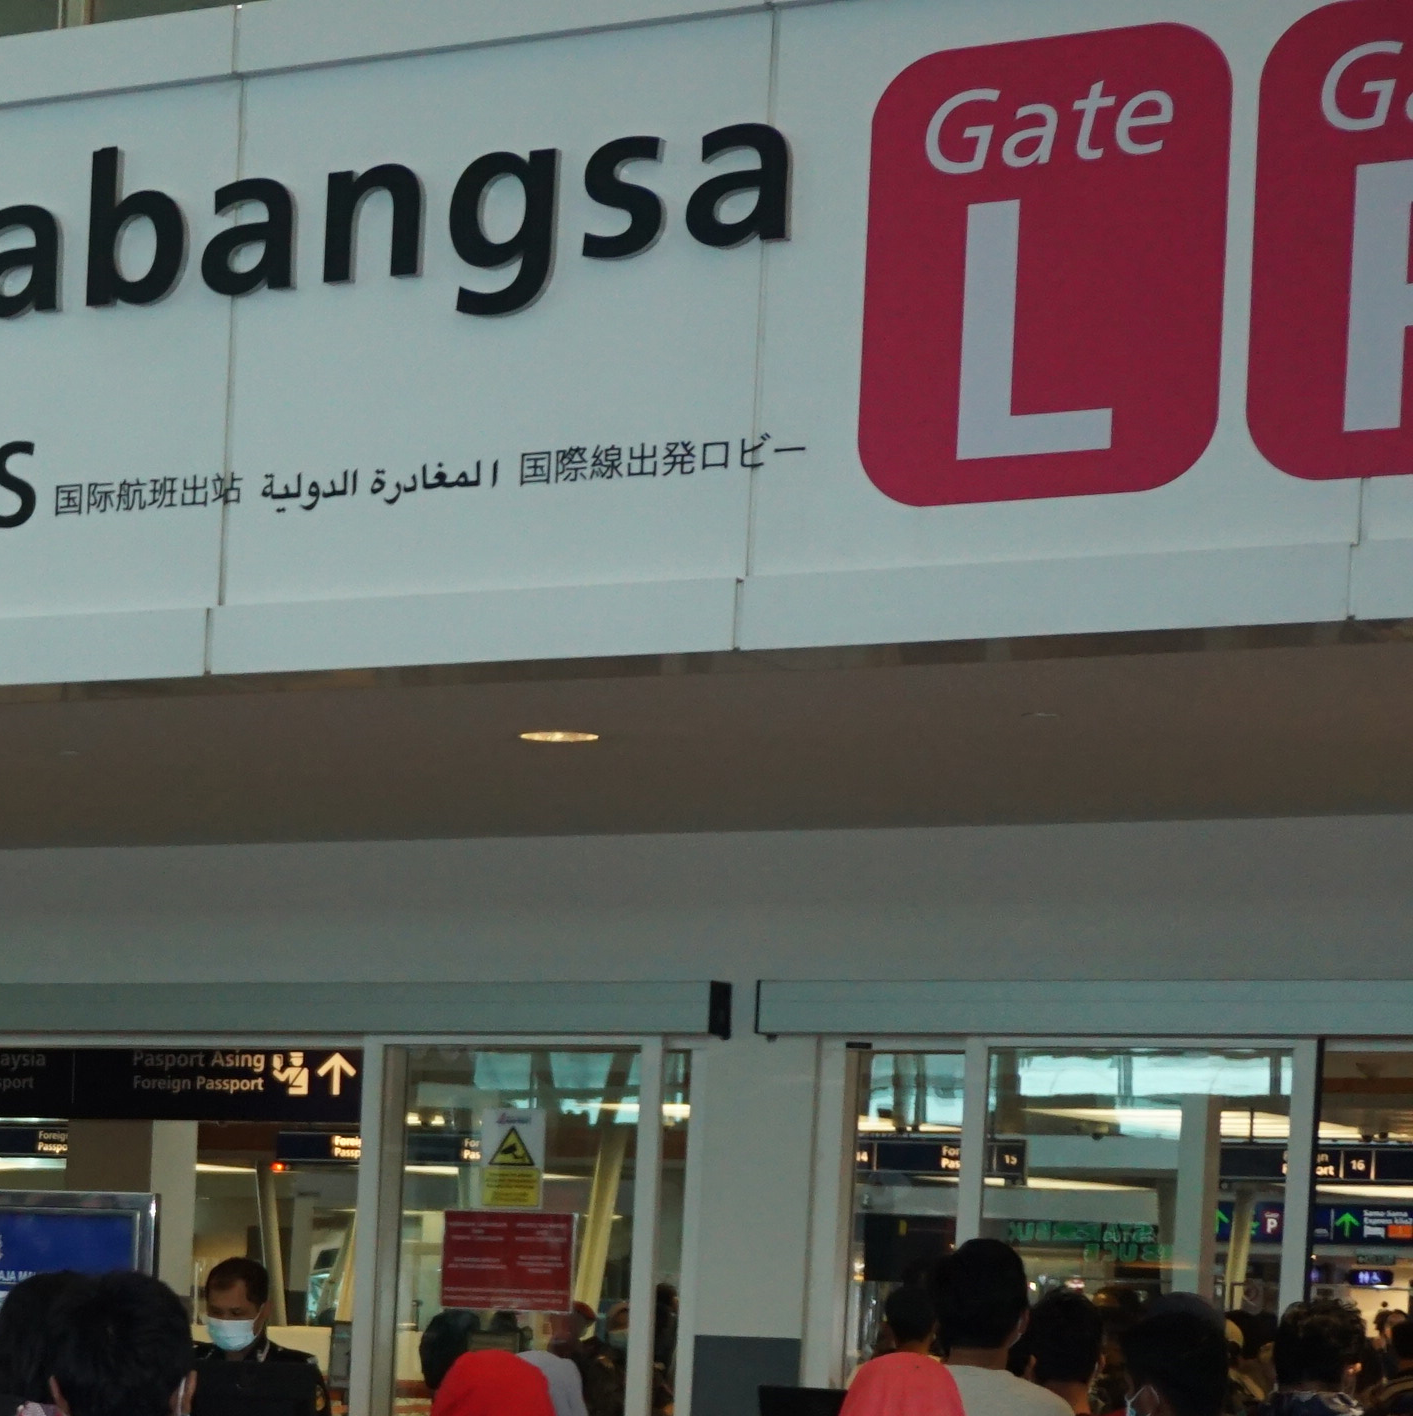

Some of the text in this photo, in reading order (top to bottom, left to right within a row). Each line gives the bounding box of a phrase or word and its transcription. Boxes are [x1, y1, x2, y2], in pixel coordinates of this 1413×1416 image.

[1321, 40, 1413, 131] G
[924, 80, 1174, 175] Gate
[956, 199, 1113, 460] L
[518, 432, 808, 488] 国際線出発ロビー
[53, 474, 243, 517] 国际航班出站
[260, 458, 500, 513] المغادرة الدولية
[132, 1050, 265, 1078] Pasport Asing
[132, 1076, 265, 1100] Foreign Passport
[37, 1141, 69, 1155] Passpo
[38, 1130, 69, 1144] Foreig
[334, 1147, 362, 1160] Passp
[1350, 1159, 1366, 1172] 16
[1266, 1218, 1278, 1235] P
